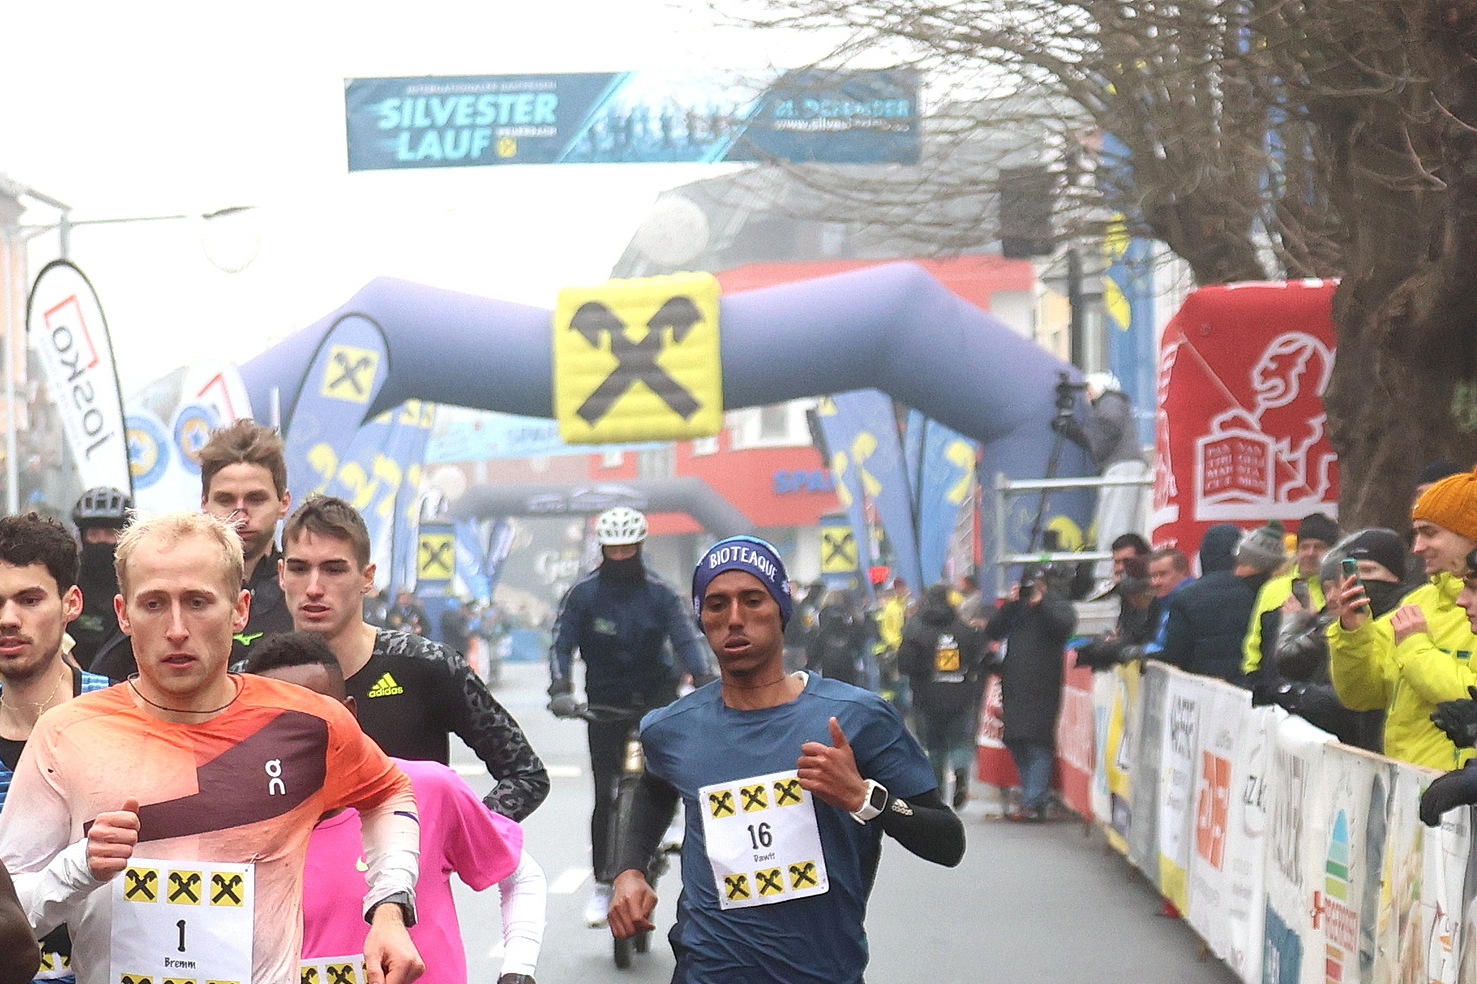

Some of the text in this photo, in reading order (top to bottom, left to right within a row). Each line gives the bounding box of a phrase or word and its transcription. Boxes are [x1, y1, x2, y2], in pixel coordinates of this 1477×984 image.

[377, 93, 559, 129] SILVESTER
[397, 128, 493, 160] LAUF
[709, 546, 778, 582] BIOTEAQUE
[368, 686, 404, 698] adidas
[747, 822, 773, 850] 16
[176, 919, 186, 952] 1
[164, 956, 196, 969] Bremm
